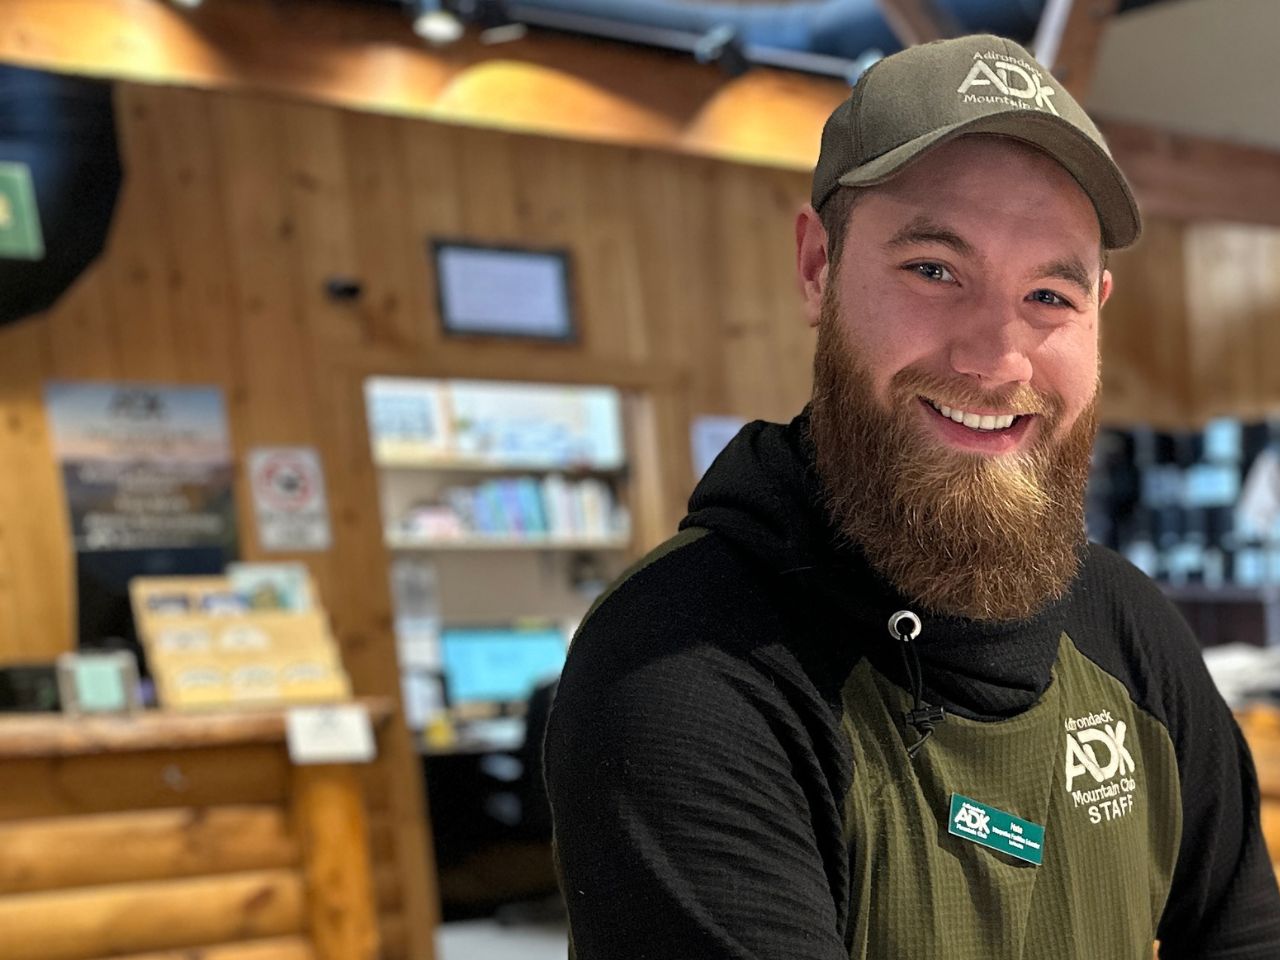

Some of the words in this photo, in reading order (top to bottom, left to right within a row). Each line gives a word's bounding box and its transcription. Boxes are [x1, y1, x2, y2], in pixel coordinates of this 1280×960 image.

[957, 60, 1060, 116] ADK
[1066, 721, 1135, 792] ADK
[1072, 782, 1120, 807] Mountain
[1088, 794, 1132, 824] STAFF
[955, 807, 990, 834] ADK
